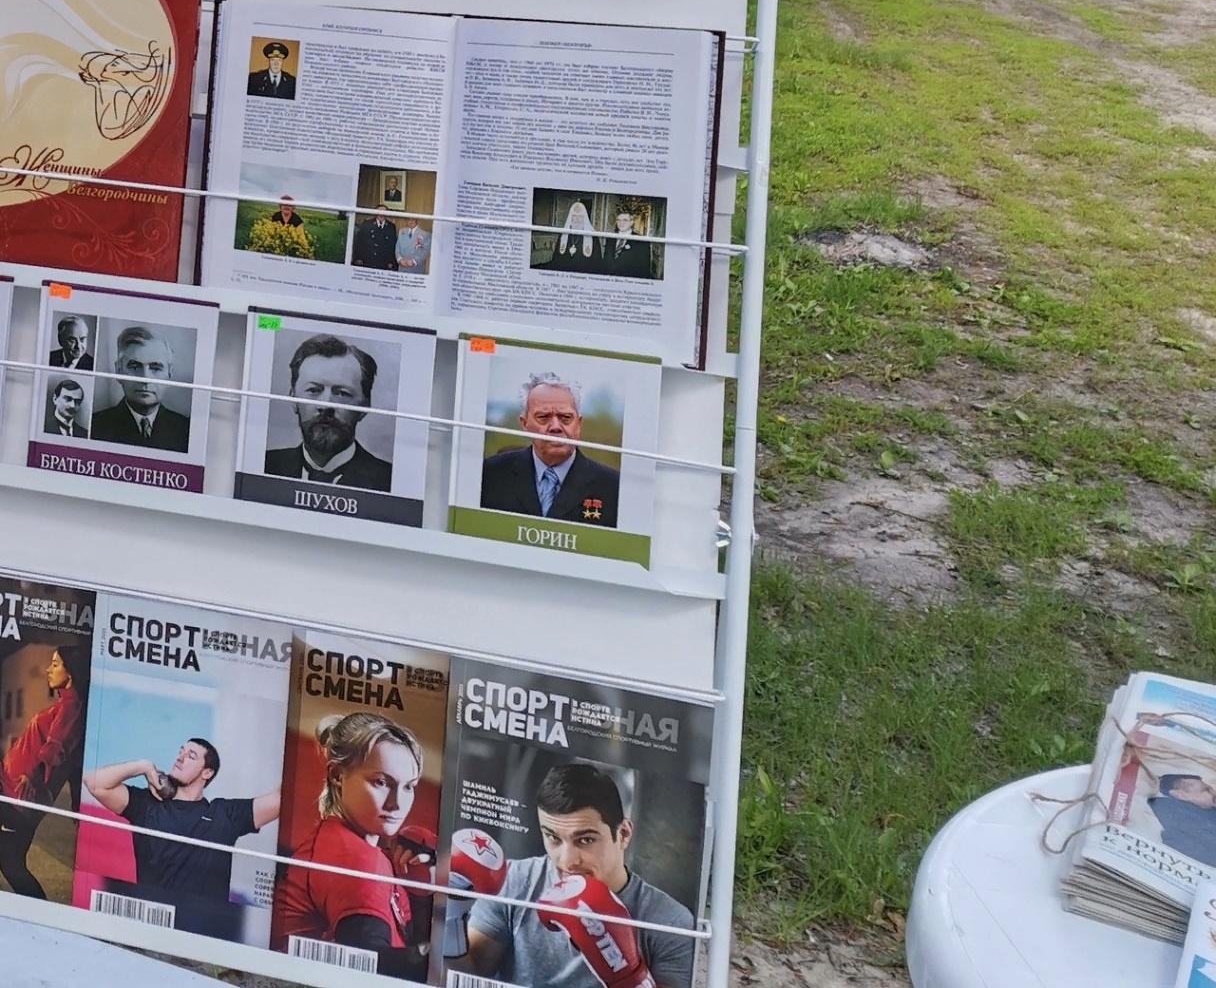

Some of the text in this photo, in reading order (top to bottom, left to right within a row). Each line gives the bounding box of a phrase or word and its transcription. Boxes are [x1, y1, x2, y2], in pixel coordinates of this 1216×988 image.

[40, 453, 188, 490] БРАТЬЯ КОСТЕНКО
[293, 490, 358, 515] ШУХОВ
[517, 525, 578, 550] ГОРИН
[108, 636, 201, 672] СМЕНА
[307, 648, 404, 685] СПОРТ
[305, 673, 404, 711] СМЕНА
[571, 707, 621, 723] РОЖДАЕТСЯ
[580, 701, 611, 714] СПОРТЕ
[464, 703, 569, 749] СМЕНА
[571, 715, 602, 727] ИСТИНА
[462, 779, 497, 794] ШАМИЛЬ
[460, 803, 521, 824] ЧЕМПИОН МИРА
[461, 796, 512, 814] ДВУКРАТНЫЙ
[460, 811, 529, 834] ПО КИКБОКСИНГУ
